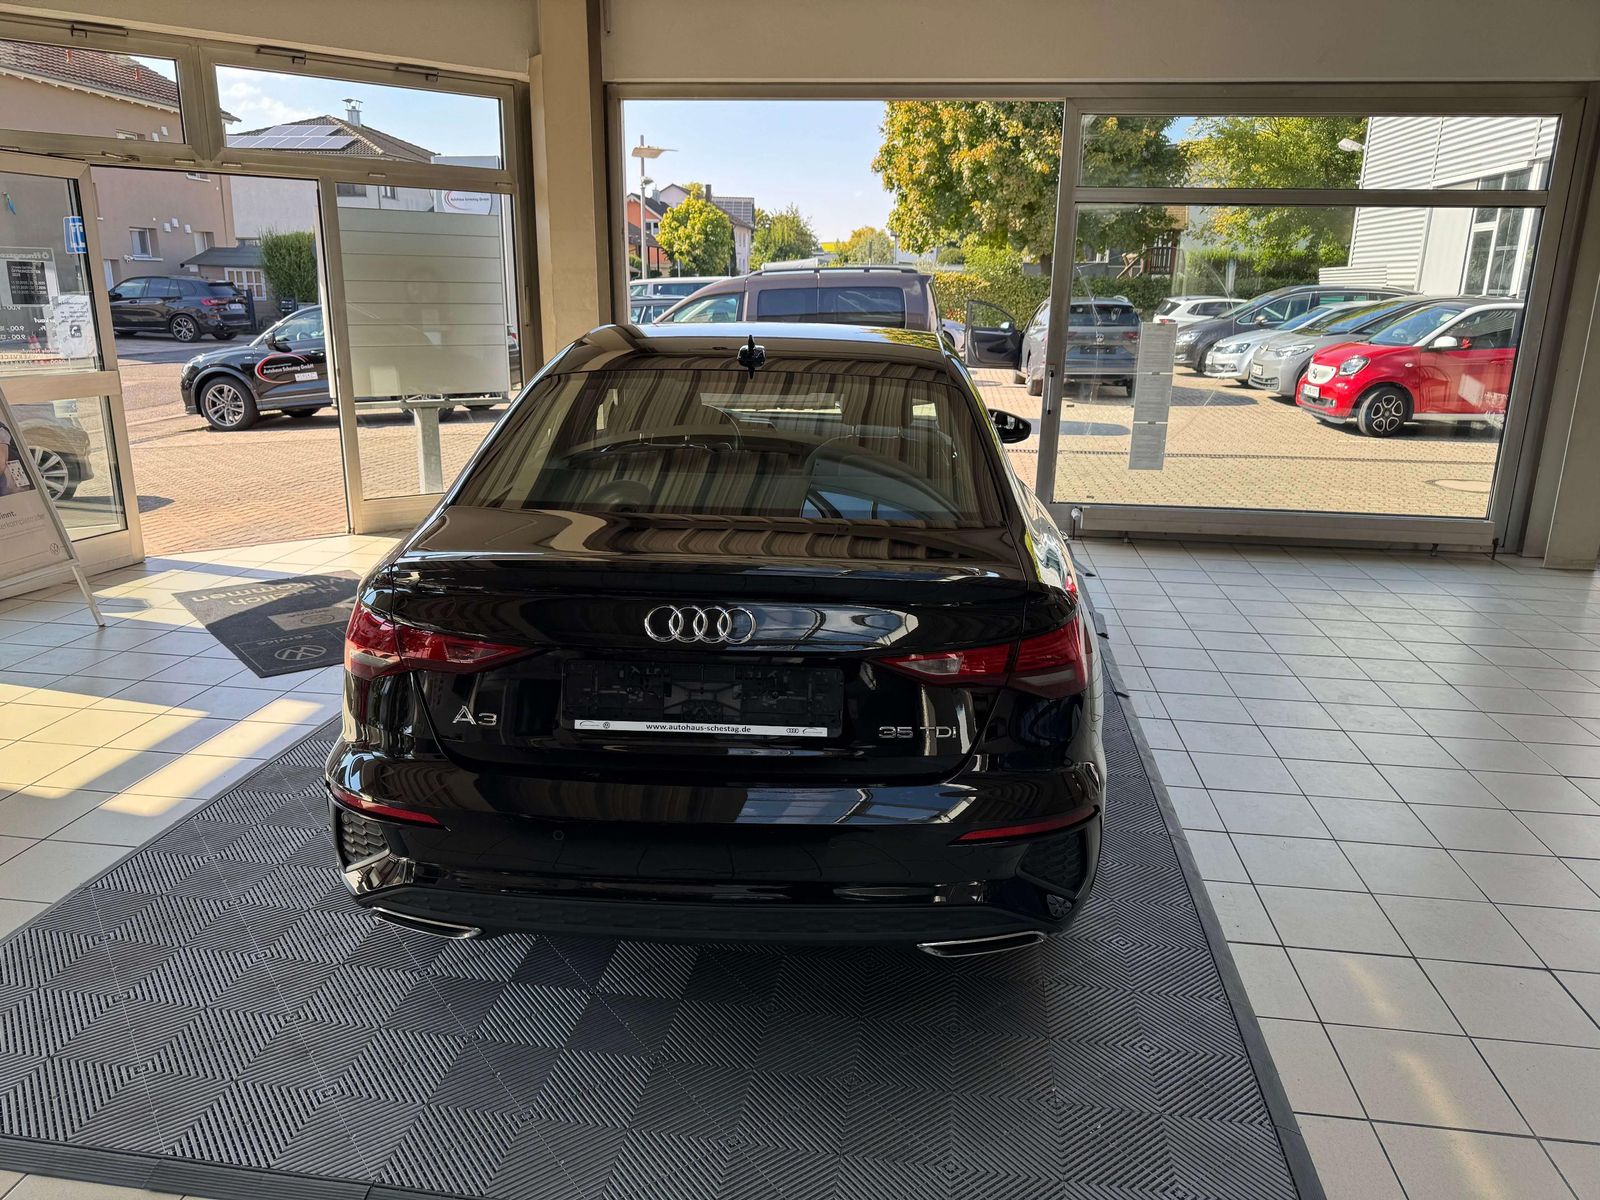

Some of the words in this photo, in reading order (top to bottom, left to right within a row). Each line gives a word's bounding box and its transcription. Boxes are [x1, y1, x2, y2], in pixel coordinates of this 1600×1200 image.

[229, 585, 341, 606] Herzlich
[257, 633, 314, 646] Service
[451, 704, 498, 727] A3
[645, 723, 752, 734] www.autohaus-schestag.de
[878, 726, 914, 739] 35
[919, 726, 957, 739] TDI
